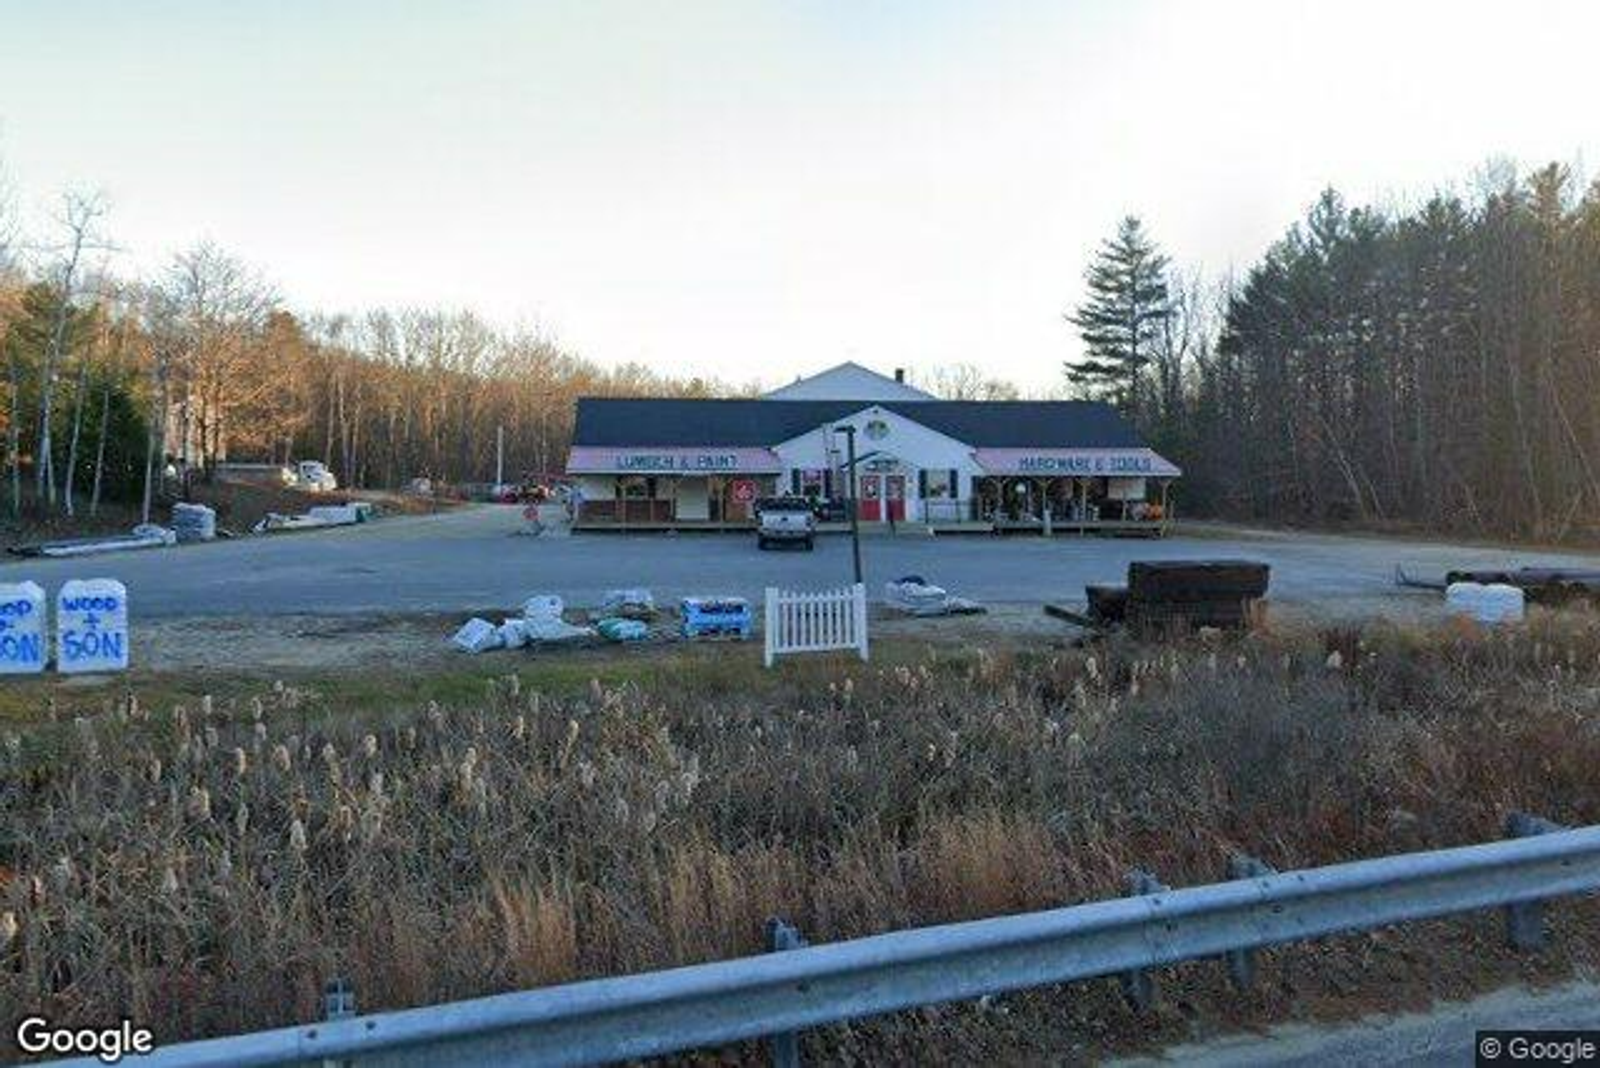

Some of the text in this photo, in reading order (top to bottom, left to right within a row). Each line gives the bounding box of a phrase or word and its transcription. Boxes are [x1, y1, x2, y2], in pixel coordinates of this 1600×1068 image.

[62, 597, 117, 612] WOOD
[83, 613, 101, 629] +
[0, 633, 39, 662] ON
[63, 631, 121, 659] SON
